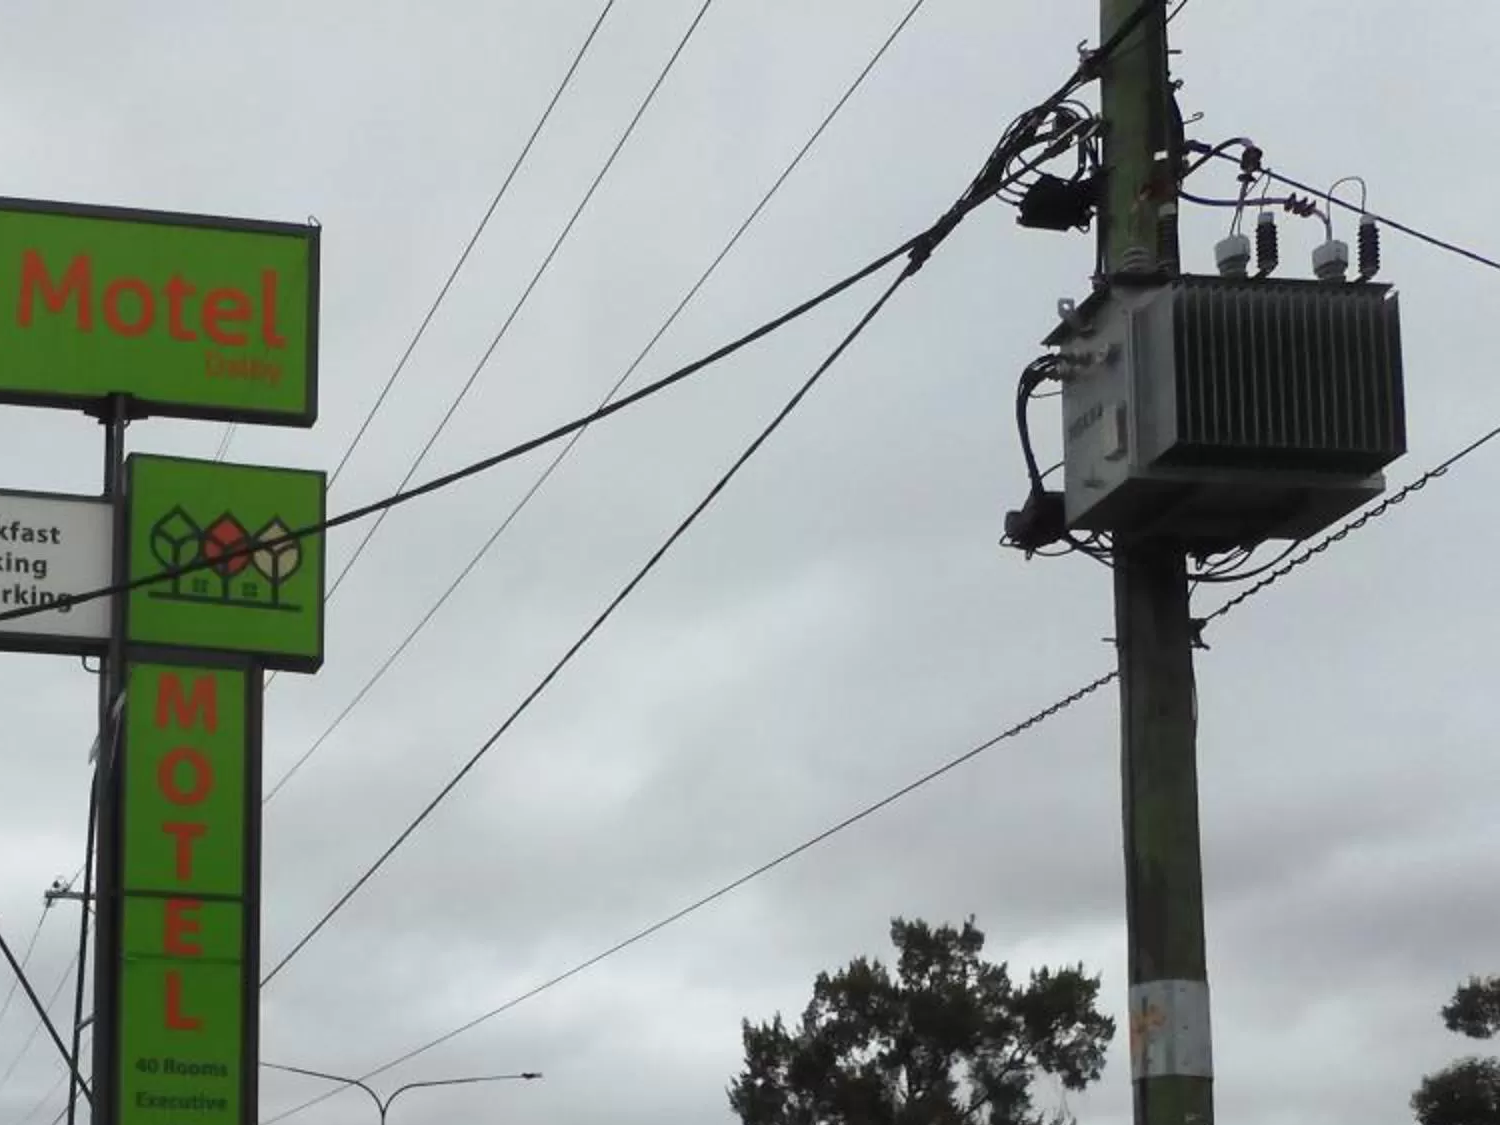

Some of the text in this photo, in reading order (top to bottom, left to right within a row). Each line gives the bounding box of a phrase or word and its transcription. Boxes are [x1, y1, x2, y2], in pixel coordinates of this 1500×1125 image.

[17, 248, 287, 350] Motel
[154, 671, 218, 1032] MOTEL
[135, 1057, 228, 1077] 40 Rooms
[135, 1091, 228, 1111] Executive
